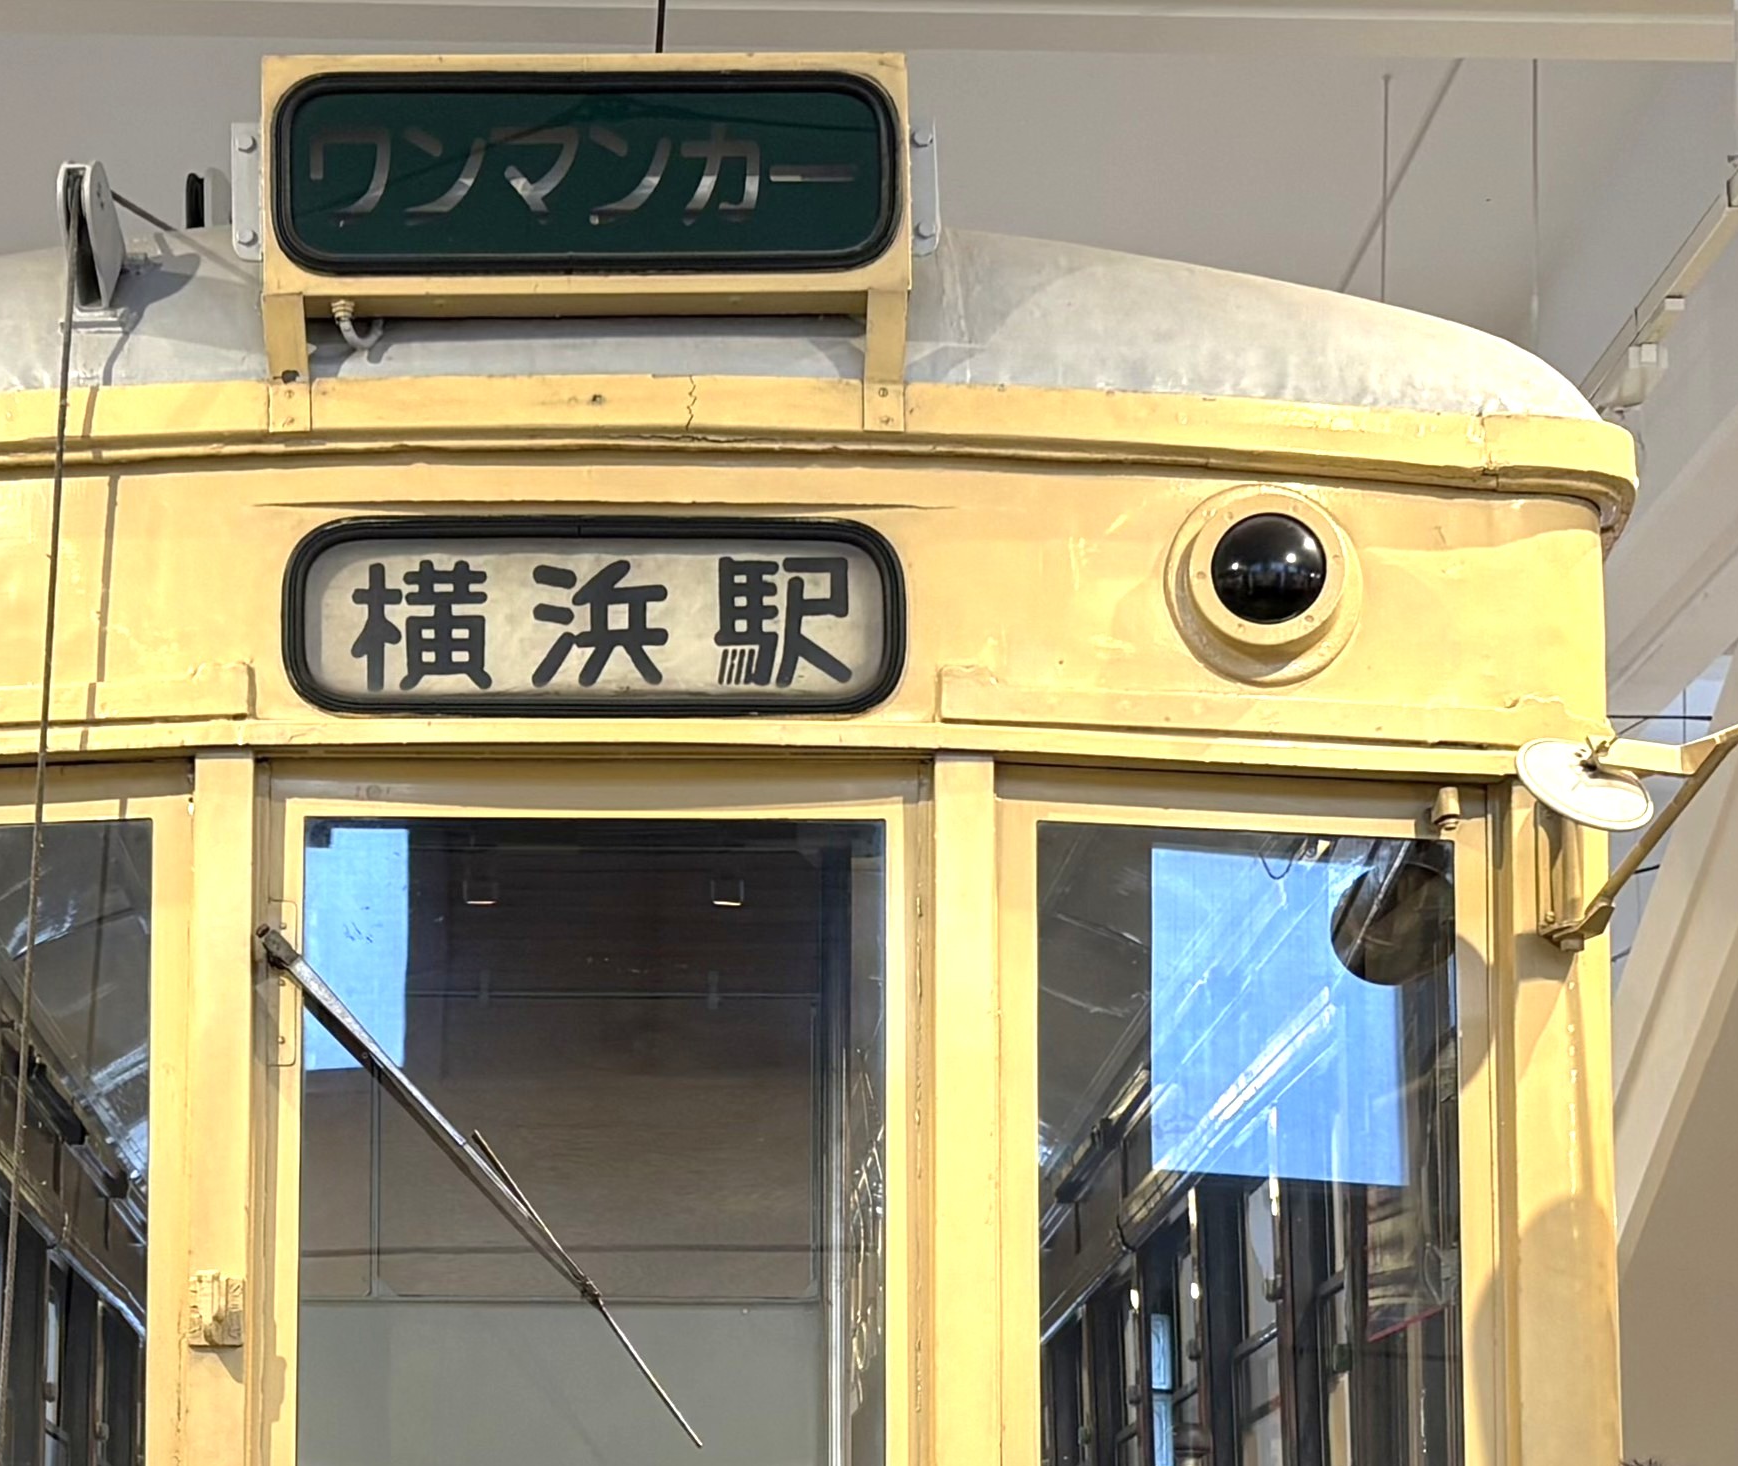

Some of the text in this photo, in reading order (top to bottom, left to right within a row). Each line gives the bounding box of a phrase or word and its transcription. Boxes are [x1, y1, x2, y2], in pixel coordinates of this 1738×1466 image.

[308, 122, 856, 227] ワンマンカー
[351, 556, 853, 692] 横浜駅
